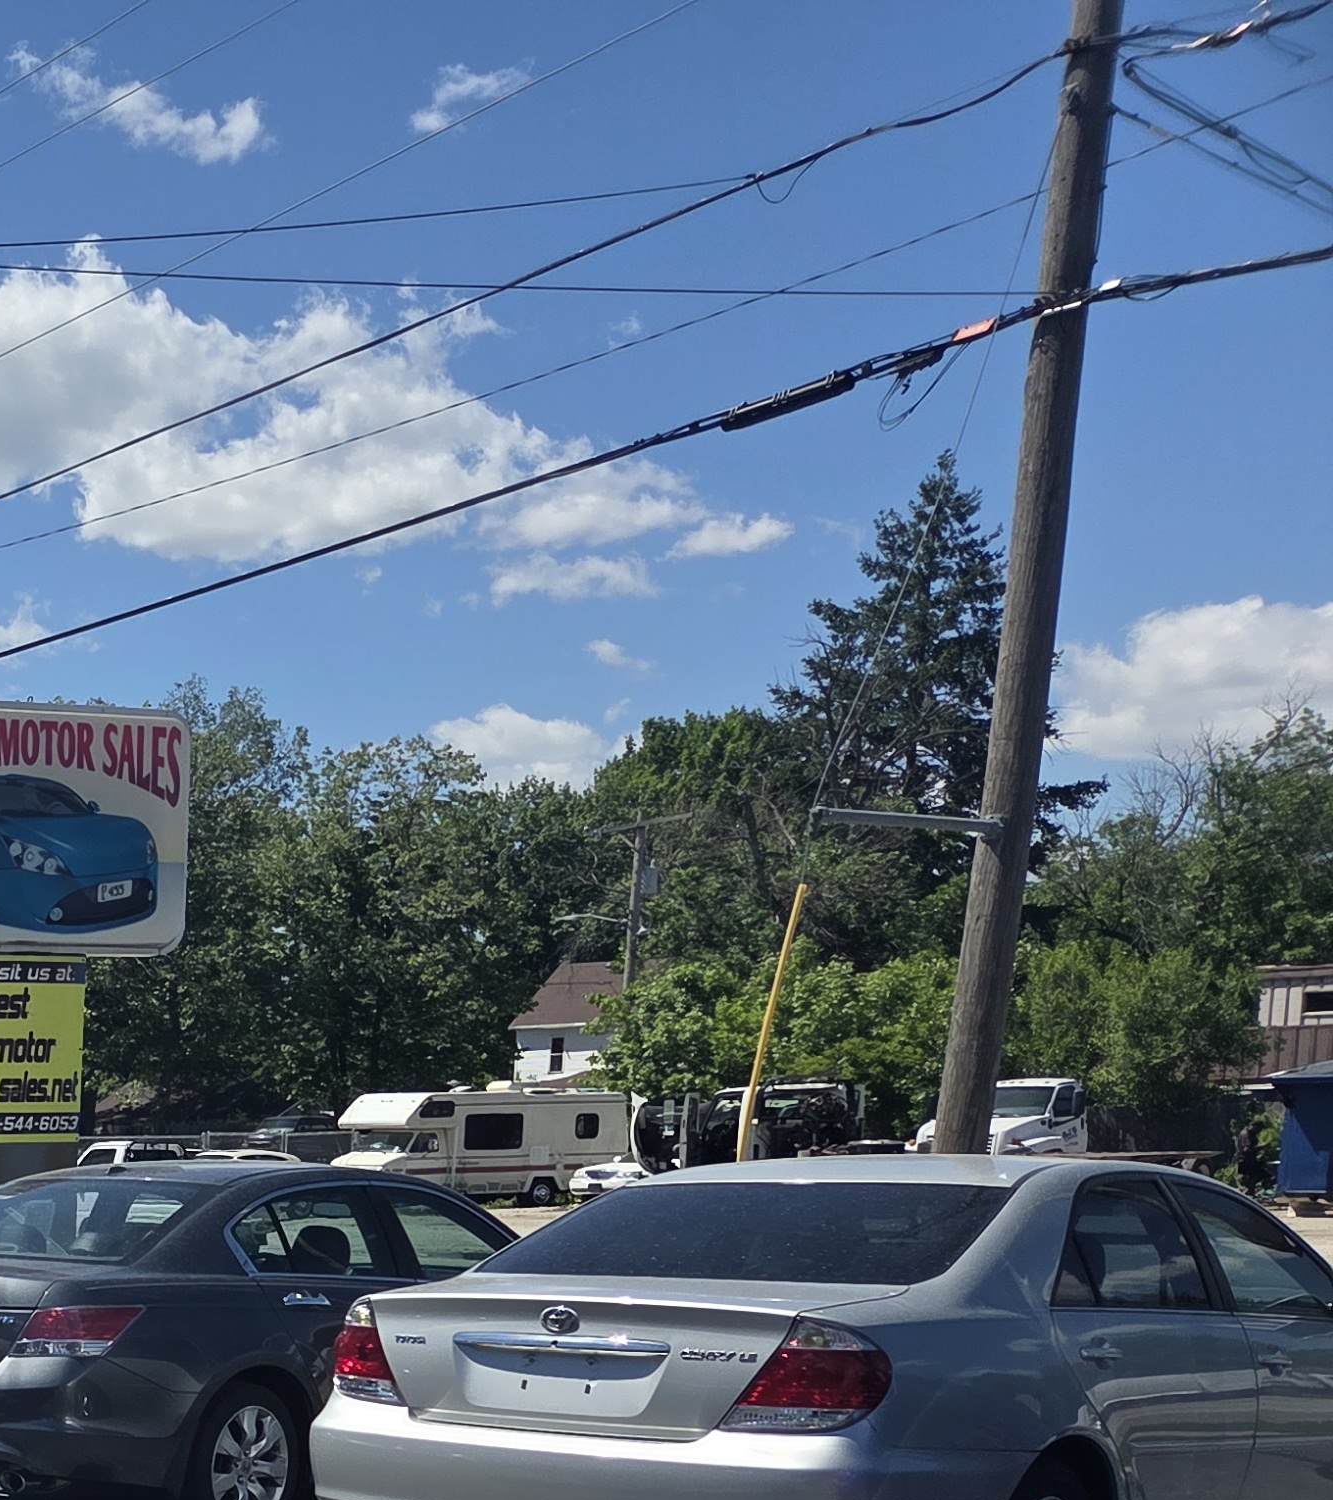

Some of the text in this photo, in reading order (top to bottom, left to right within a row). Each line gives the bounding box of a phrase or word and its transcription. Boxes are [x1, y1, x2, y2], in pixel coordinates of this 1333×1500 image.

[102, 723, 182, 808] SALES
[27, 967, 51, 980] us
[55, 964, 77, 981] at:
